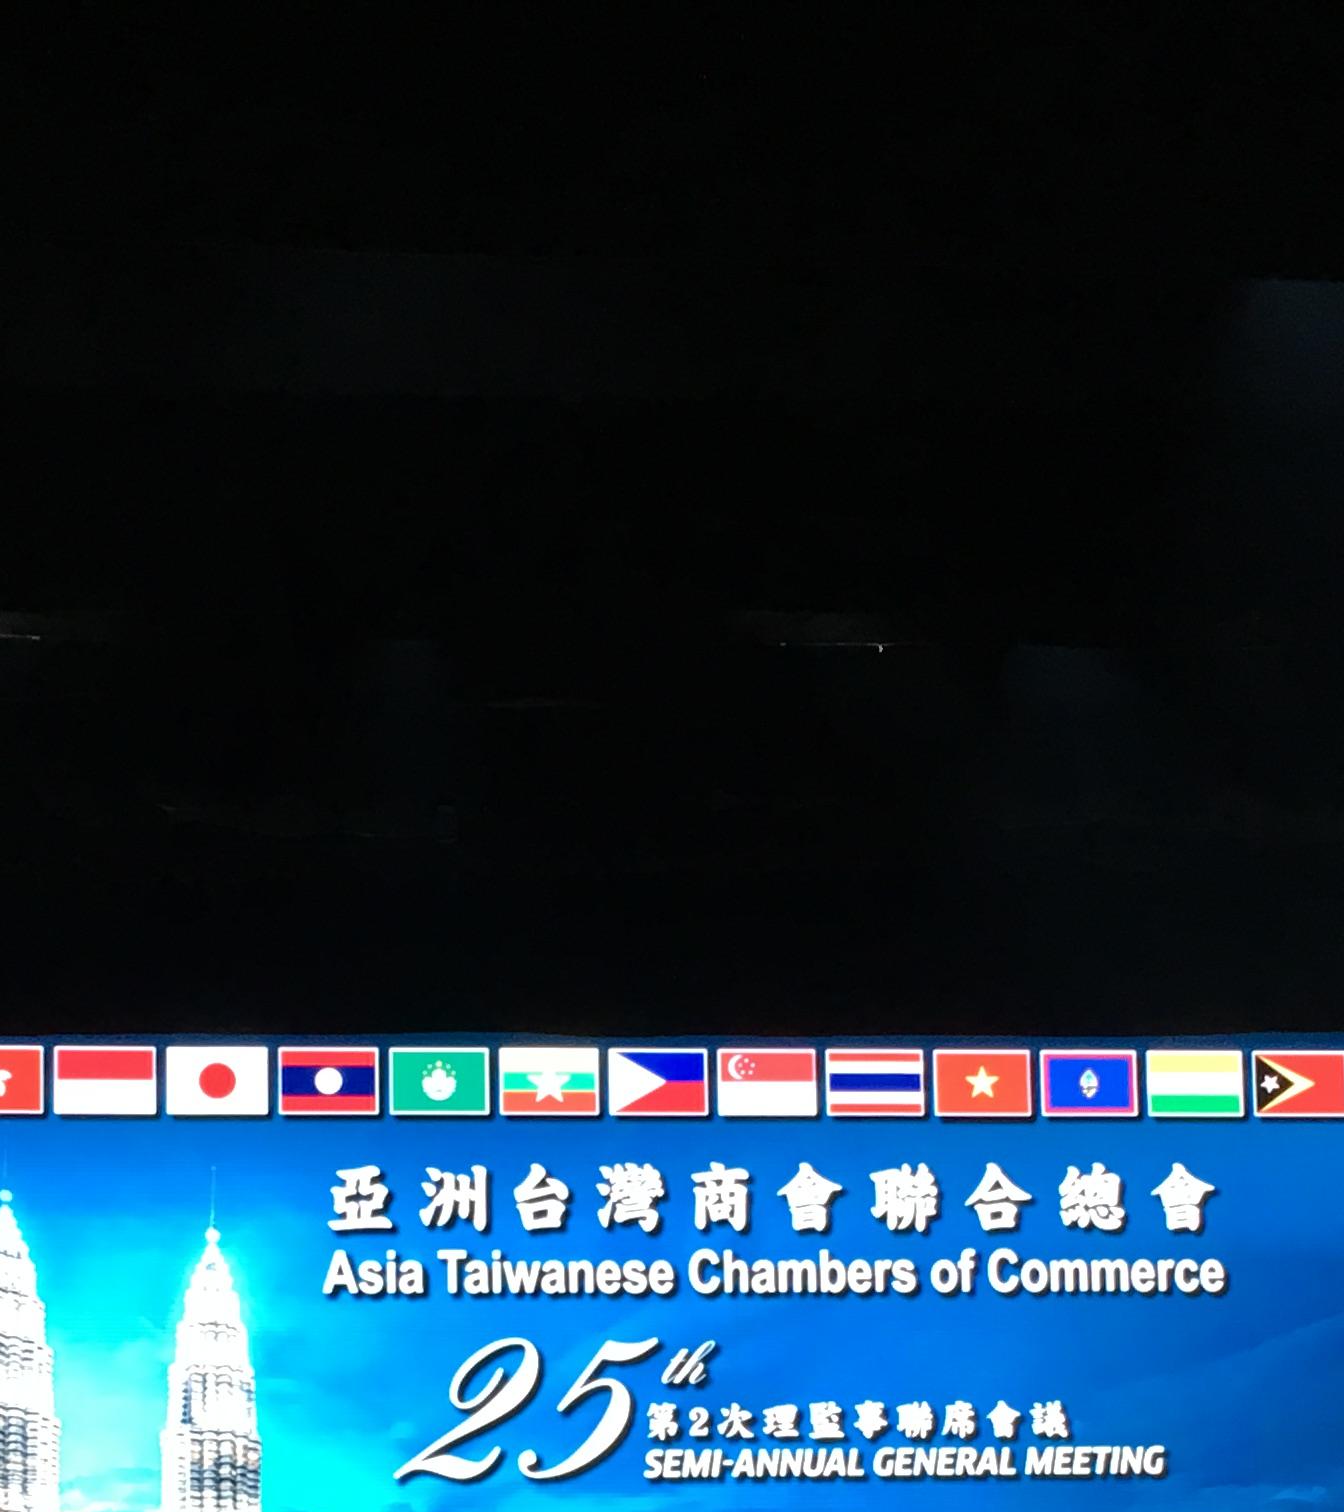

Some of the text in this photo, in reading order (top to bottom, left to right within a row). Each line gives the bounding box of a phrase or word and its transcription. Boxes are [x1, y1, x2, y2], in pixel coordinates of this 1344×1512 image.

[327, 1161, 1216, 1233] 亞洲台灣商會聯合總會
[322, 1247, 1226, 1294] Asia Taiwanese Chambers of Commerce
[645, 1400, 1069, 1441] 第2次理監事聯席會議
[643, 1445, 1166, 1480] SEMI-ANNUAL GENERAL MEETING
